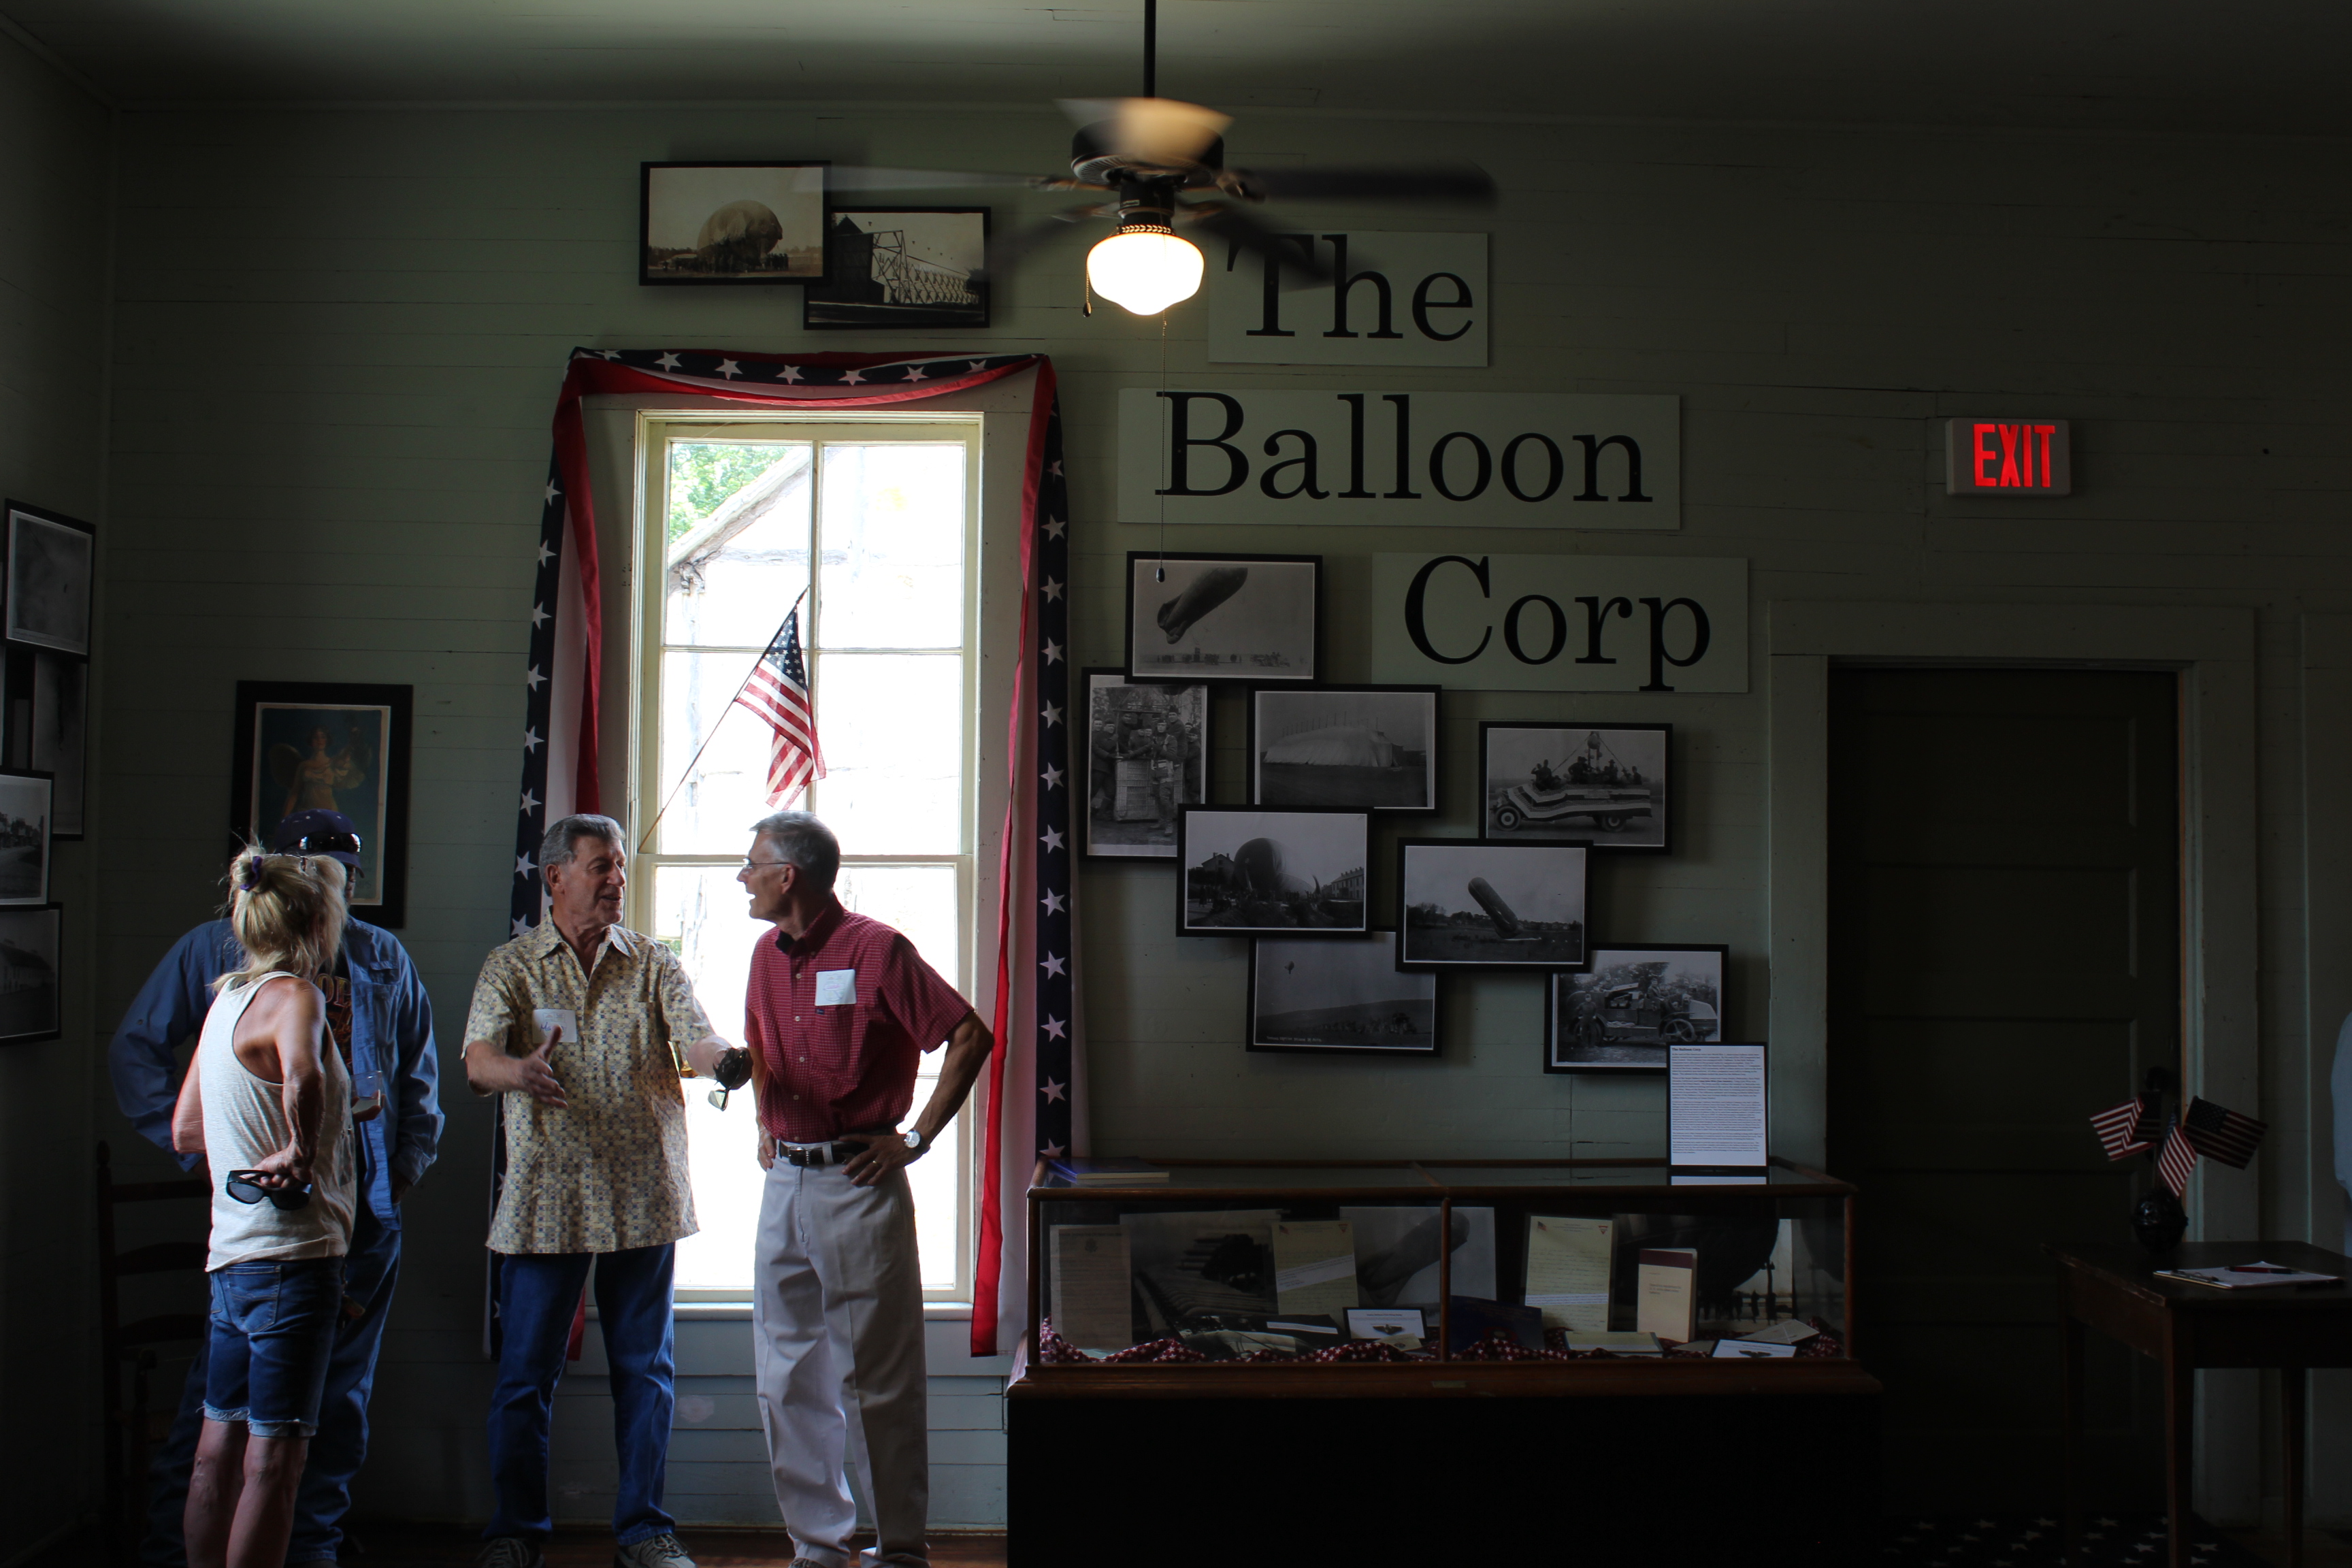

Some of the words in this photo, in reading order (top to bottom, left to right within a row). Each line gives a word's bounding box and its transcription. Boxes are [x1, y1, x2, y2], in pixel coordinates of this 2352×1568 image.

[1226, 233, 1473, 342] The
[1154, 391, 1653, 502] Balloon
[1973, 423, 2056, 488] EXIT
[1405, 555, 1711, 691] Corp
